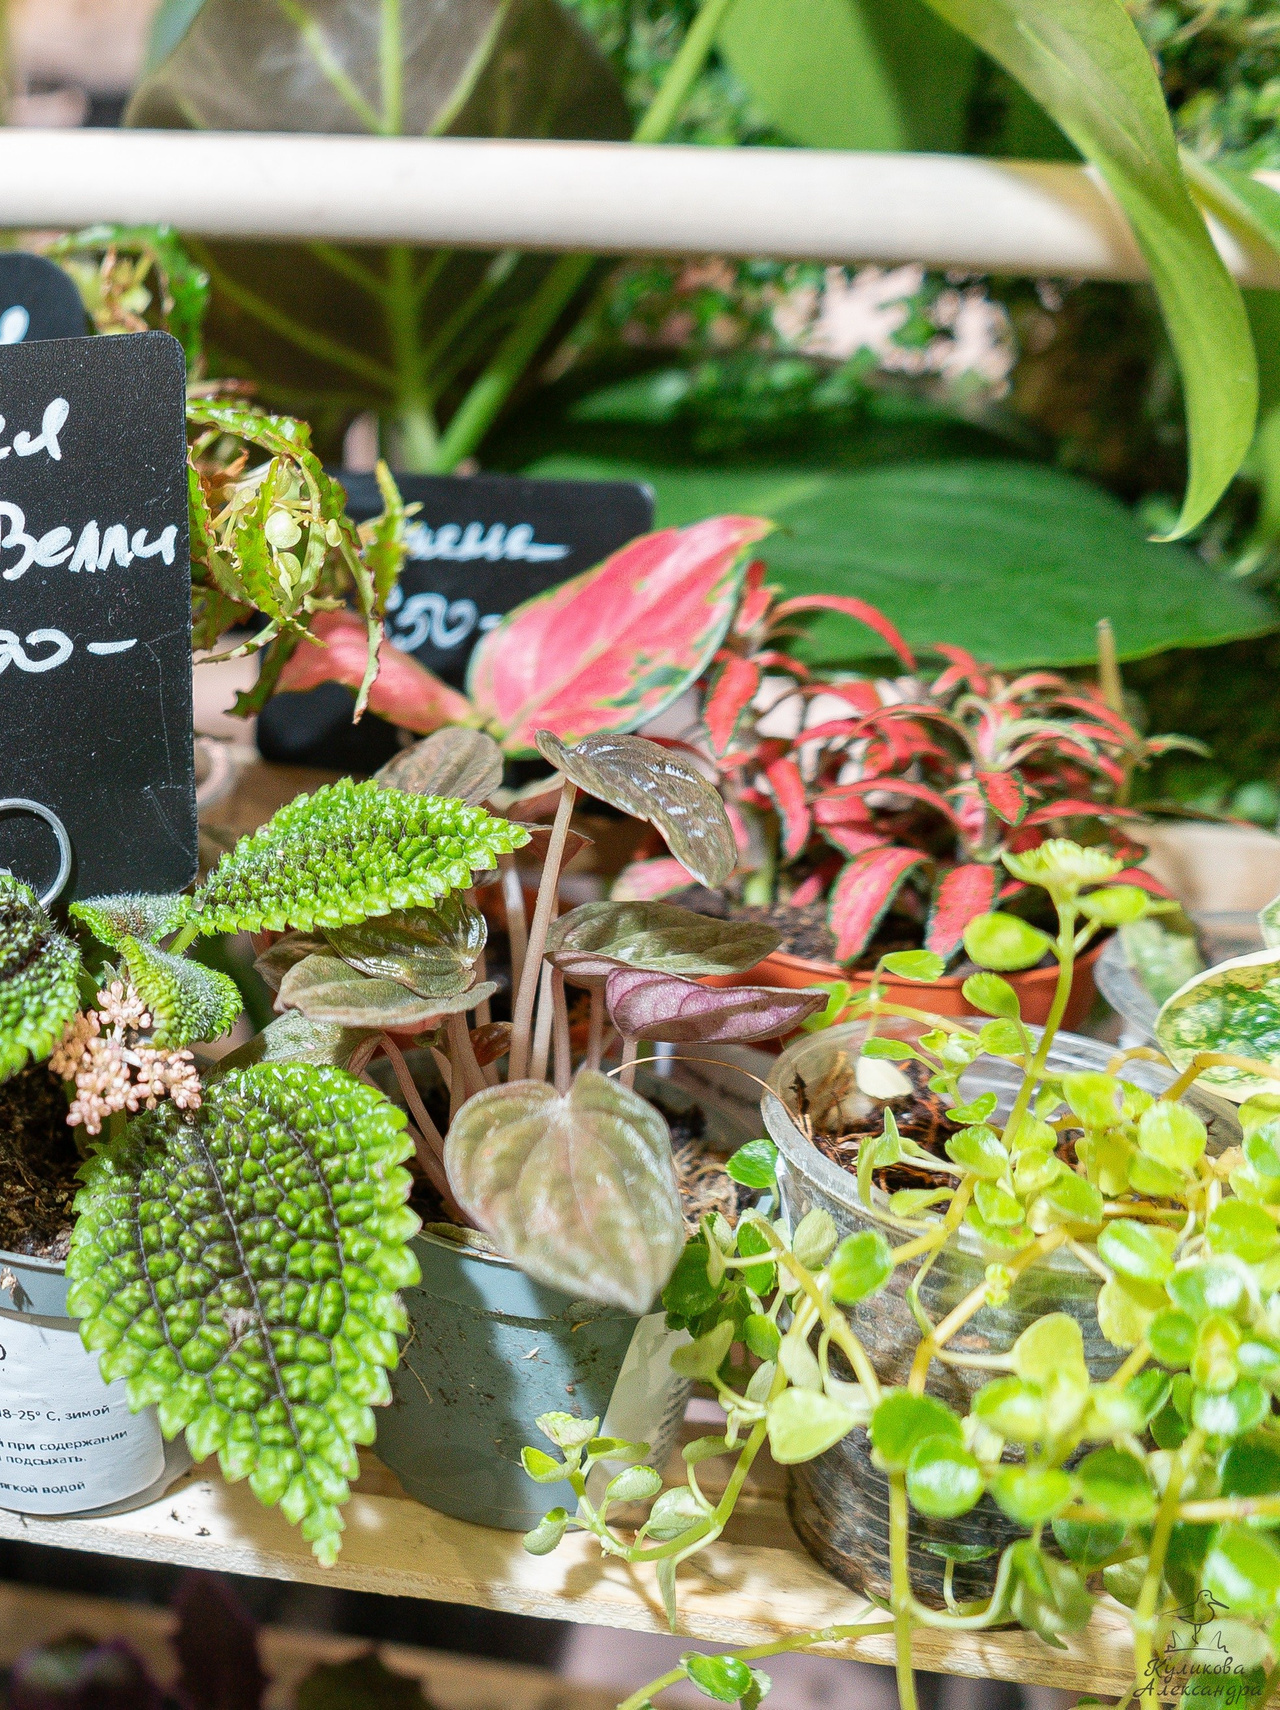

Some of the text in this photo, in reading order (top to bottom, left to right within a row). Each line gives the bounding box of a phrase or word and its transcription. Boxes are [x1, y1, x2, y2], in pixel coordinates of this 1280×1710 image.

[384, 585, 504, 653] 50-
[65, 1404, 111, 1421] зимой
[7, 1440, 36, 1452] при
[39, 1430, 129, 1452] содержании
[41, 1481, 87, 1495] водой
